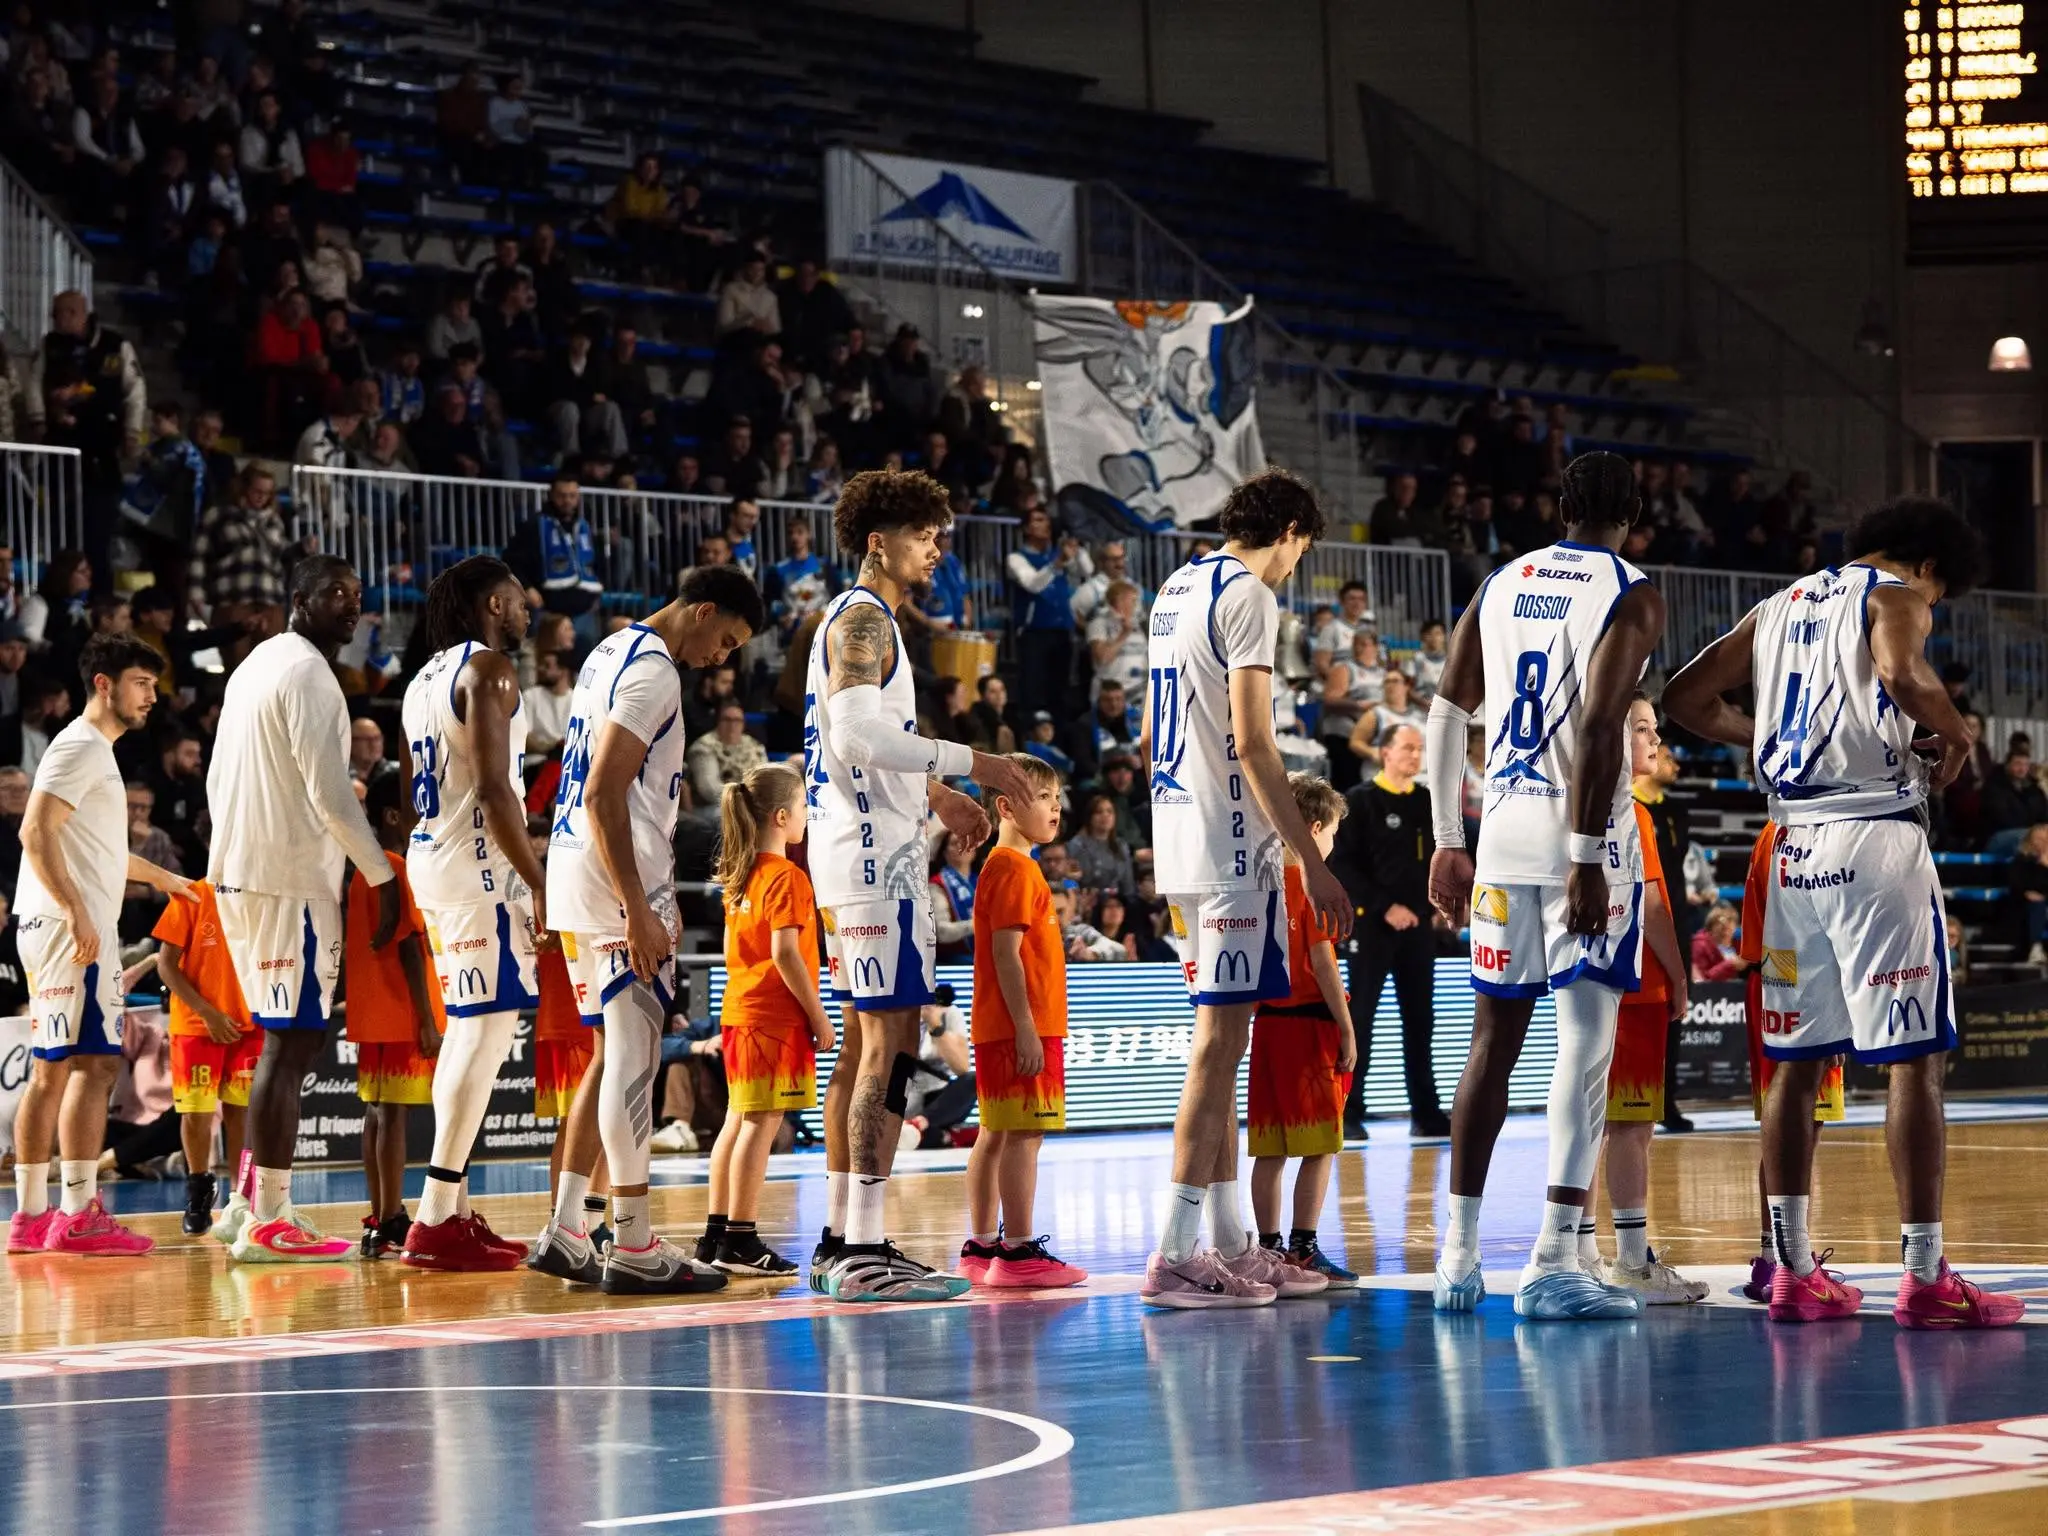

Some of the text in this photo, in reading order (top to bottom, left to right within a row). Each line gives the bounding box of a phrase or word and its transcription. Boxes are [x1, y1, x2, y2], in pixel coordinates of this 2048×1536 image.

[1536, 568, 1593, 583] SUZUKI
[1513, 593, 1572, 620] DOSSOU
[1509, 650, 1549, 750] 8
[1202, 916, 1258, 934] Lengronne
[1867, 964, 1930, 990] Lengronne
[191, 1065, 212, 1085] 18
[300, 1072, 358, 1096] Cuisin
